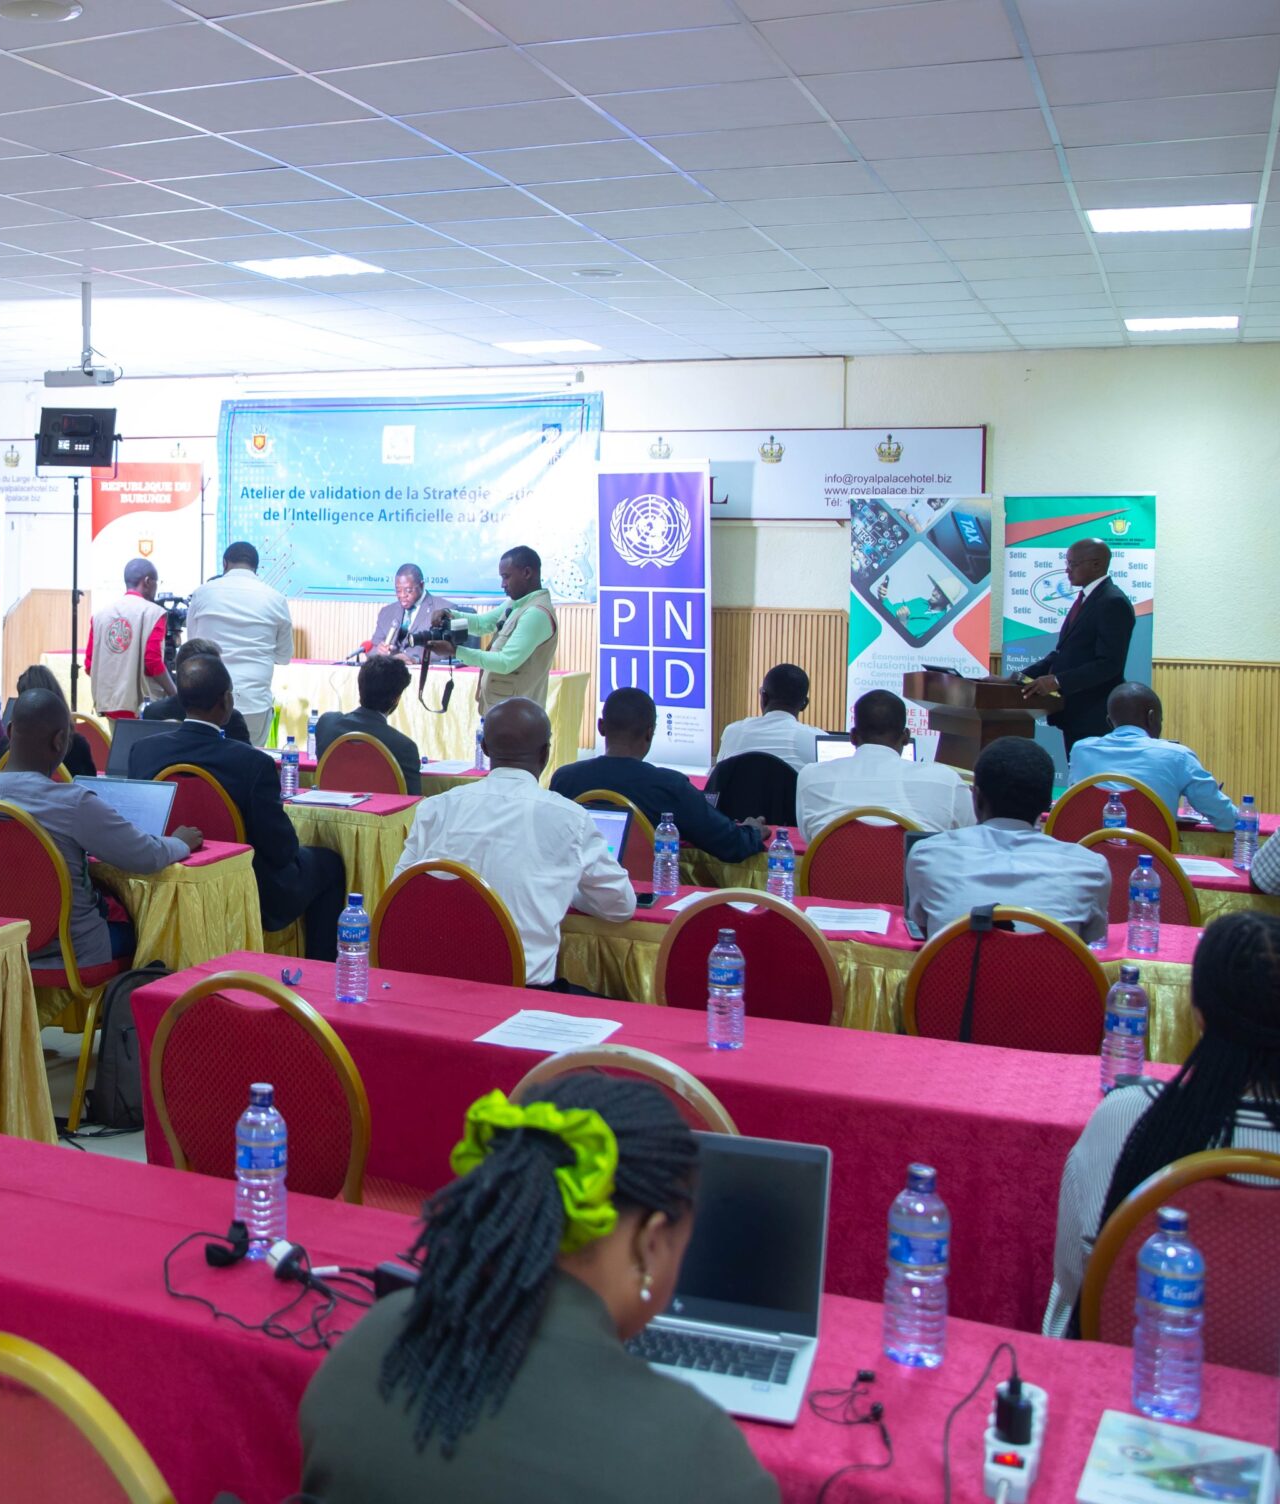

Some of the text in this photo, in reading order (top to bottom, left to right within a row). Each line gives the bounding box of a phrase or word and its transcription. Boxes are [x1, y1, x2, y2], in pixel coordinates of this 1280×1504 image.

[824, 473, 952, 485] info@royalpalacehotel.biz
[101, 481, 191, 492] REPUBLIQUE DU
[120, 493, 172, 504] BURUNDI
[240, 486, 285, 499] Atelier
[288, 486, 306, 499] de
[310, 486, 380, 500] validation
[384, 486, 403, 500] de
[406, 486, 419, 500] la
[423, 486, 491, 504] Stratégie
[263, 508, 280, 521] de
[377, 508, 454, 523] Artificielle
[457, 511, 476, 523] au
[960, 520, 982, 544] TAX
[1009, 551, 1027, 559] Setic
[1128, 562, 1148, 570] Setic
[1008, 570, 1027, 578] Setic
[1109, 570, 1128, 578] Setic
[431, 576, 449, 584] 2026
[1132, 580, 1152, 588] Setic
[1013, 606, 1032, 614] Setic
[613, 598, 693, 640] P N
[1038, 616, 1058, 624] Setic
[1006, 655, 1038, 663] Rendre le
[856, 660, 906, 670] Inclusion
[665, 659, 695, 699] D
[342, 928, 367, 939] Kinju
